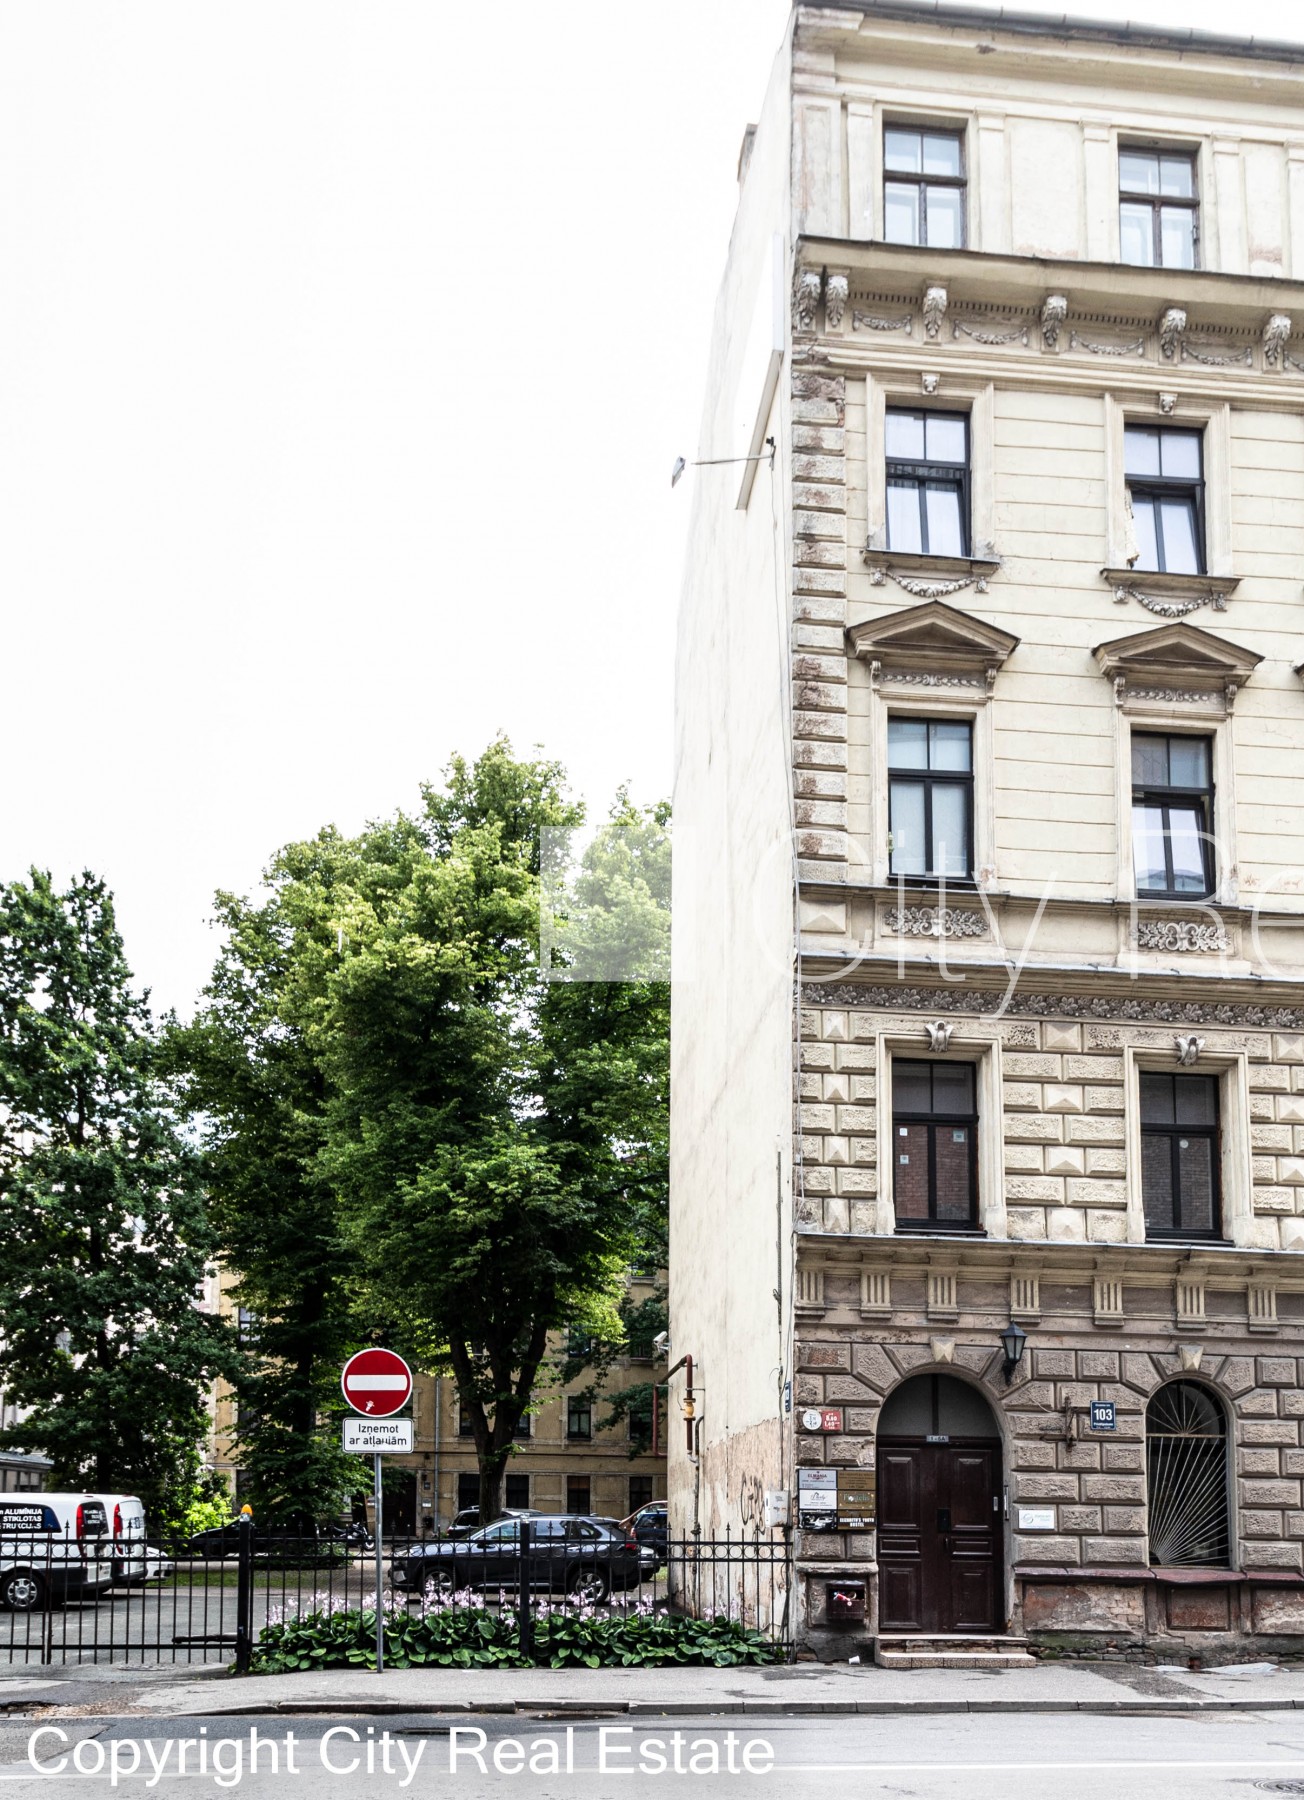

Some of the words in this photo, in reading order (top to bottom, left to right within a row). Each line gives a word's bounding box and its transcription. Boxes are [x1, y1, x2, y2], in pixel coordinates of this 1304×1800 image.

[1093, 1408, 1113, 1421] 103
[358, 1423, 399, 1435] Izņemot
[349, 1437, 361, 1445] ar
